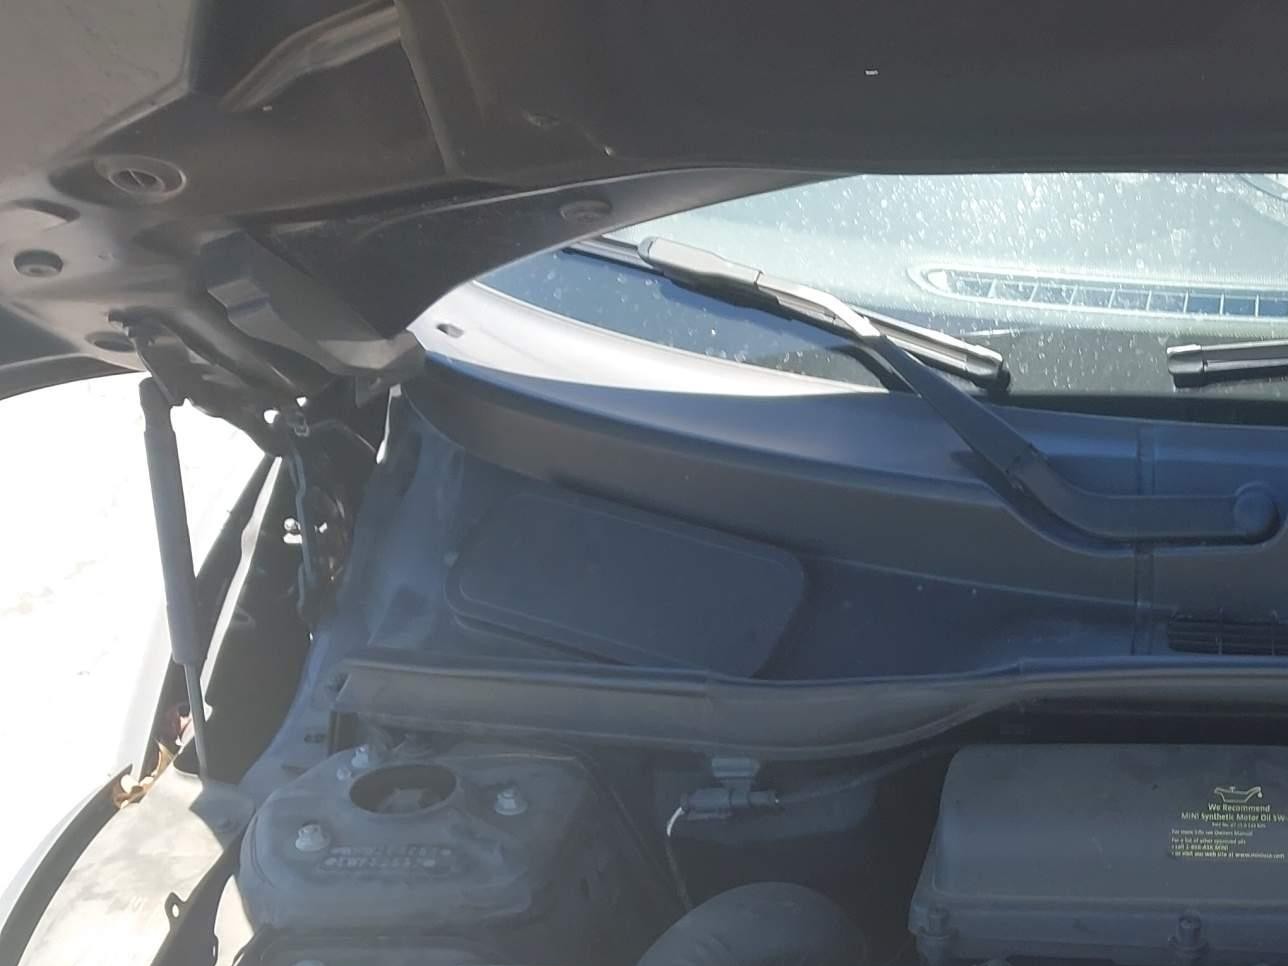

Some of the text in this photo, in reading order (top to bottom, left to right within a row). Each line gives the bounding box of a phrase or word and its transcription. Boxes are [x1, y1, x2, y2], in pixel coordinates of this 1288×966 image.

[1208, 803, 1271, 813] We Recommend
[1181, 812, 1200, 820] MINI
[1201, 813, 1234, 822] Synthetic
[1236, 813, 1259, 822] Motor
[1260, 814, 1271, 822] Oil
